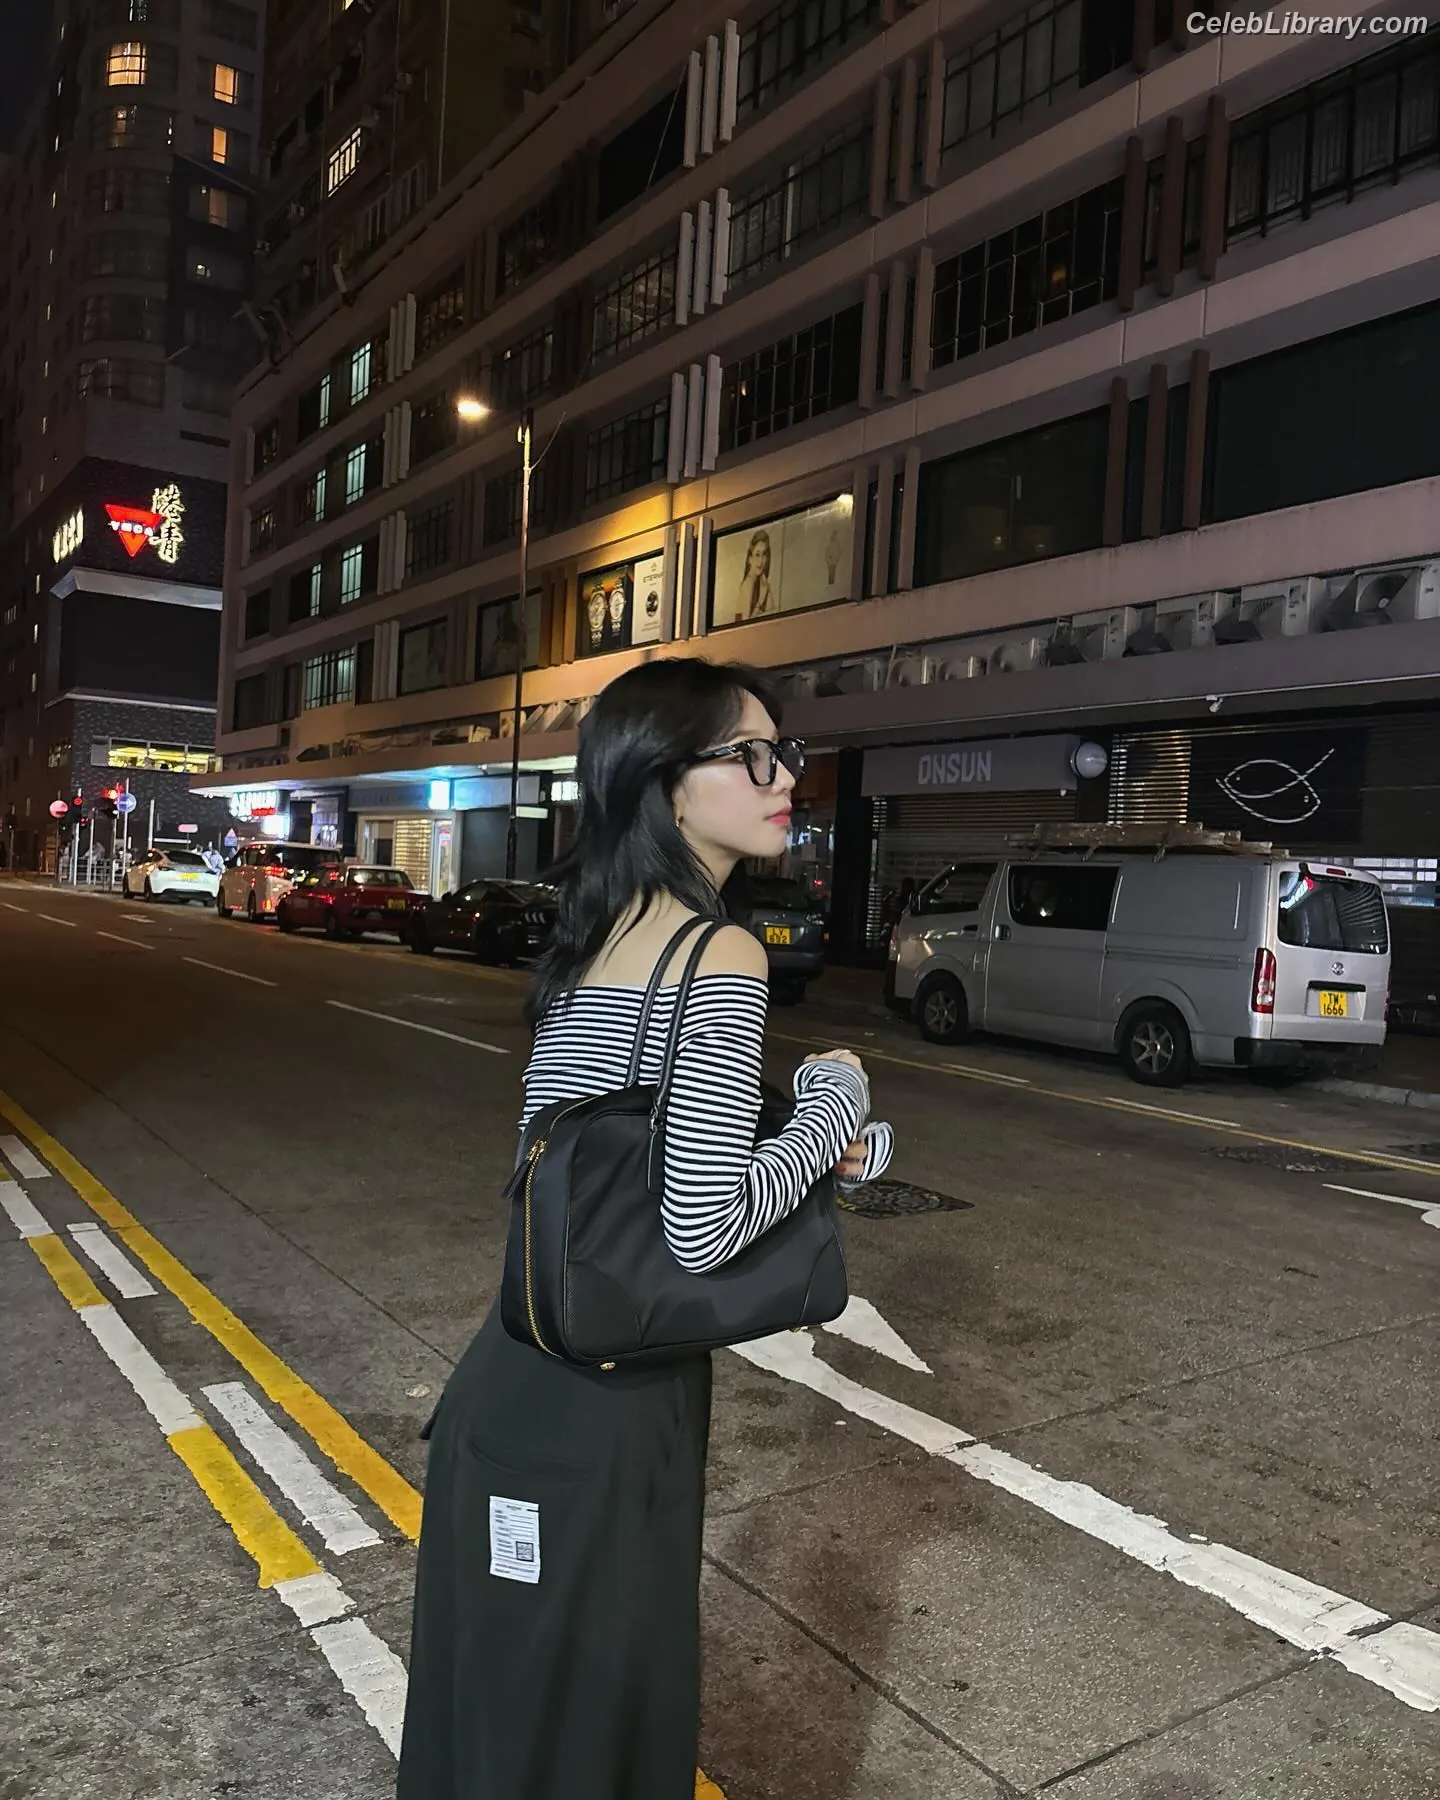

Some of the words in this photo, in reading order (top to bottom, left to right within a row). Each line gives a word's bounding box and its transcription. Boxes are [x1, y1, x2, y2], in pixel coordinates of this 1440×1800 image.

[918, 751, 992, 784] ONSUN
[1328, 992, 1339, 1005] TW
[1323, 1003, 1344, 1016] 1666
